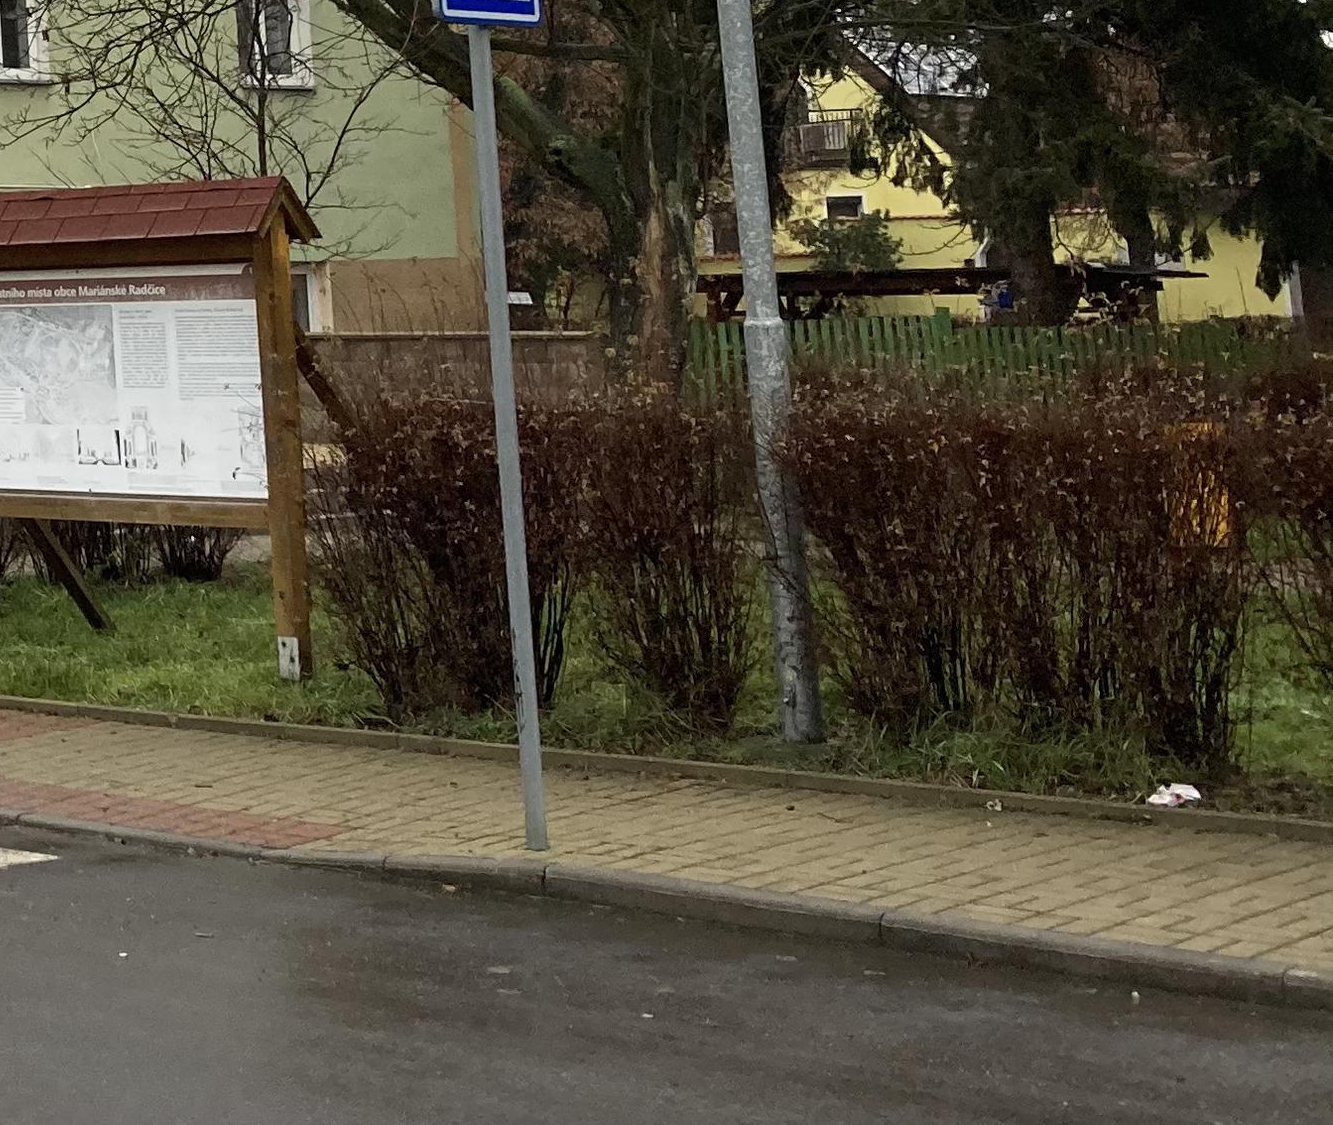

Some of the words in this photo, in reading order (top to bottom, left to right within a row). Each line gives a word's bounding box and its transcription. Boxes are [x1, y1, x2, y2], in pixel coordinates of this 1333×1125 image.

[27, 286, 53, 298] místa
[53, 286, 77, 297] obce
[78, 284, 127, 296] Mariánské
[128, 283, 166, 295] Radčice
